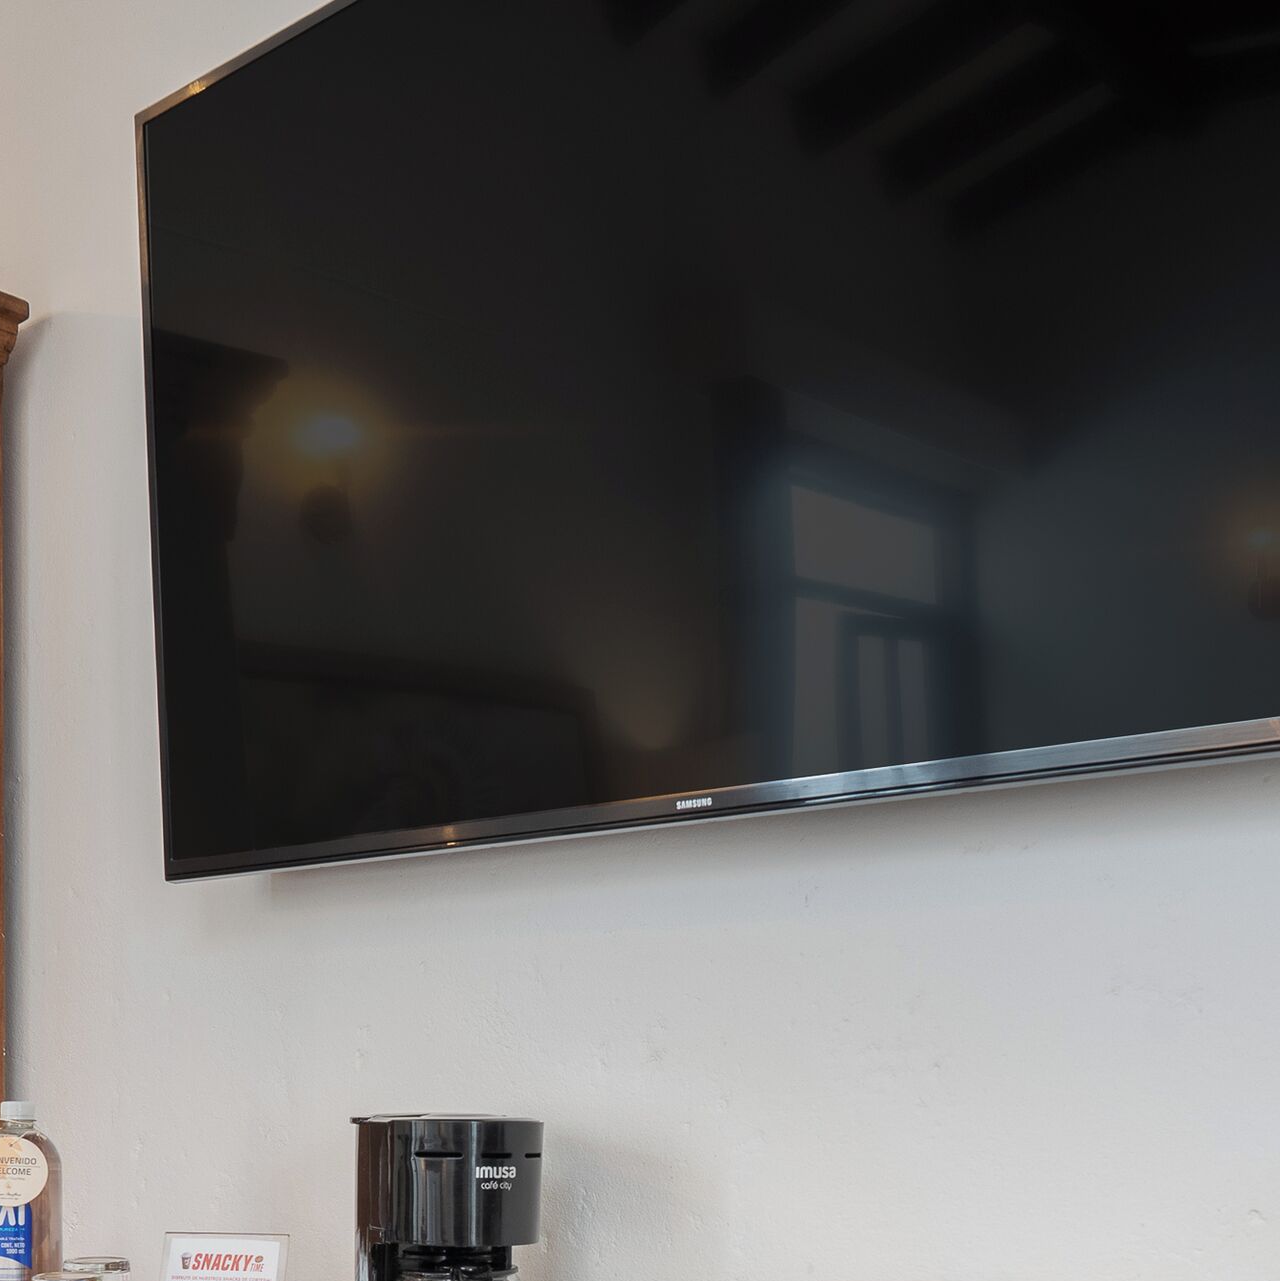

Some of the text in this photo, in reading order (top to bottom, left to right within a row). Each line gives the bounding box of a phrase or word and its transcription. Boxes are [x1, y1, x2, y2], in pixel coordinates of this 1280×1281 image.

[676, 797, 712, 809] SAMSUNG
[481, 1180, 512, 1191] café city
[192, 1253, 264, 1272] SNACKY TIME
